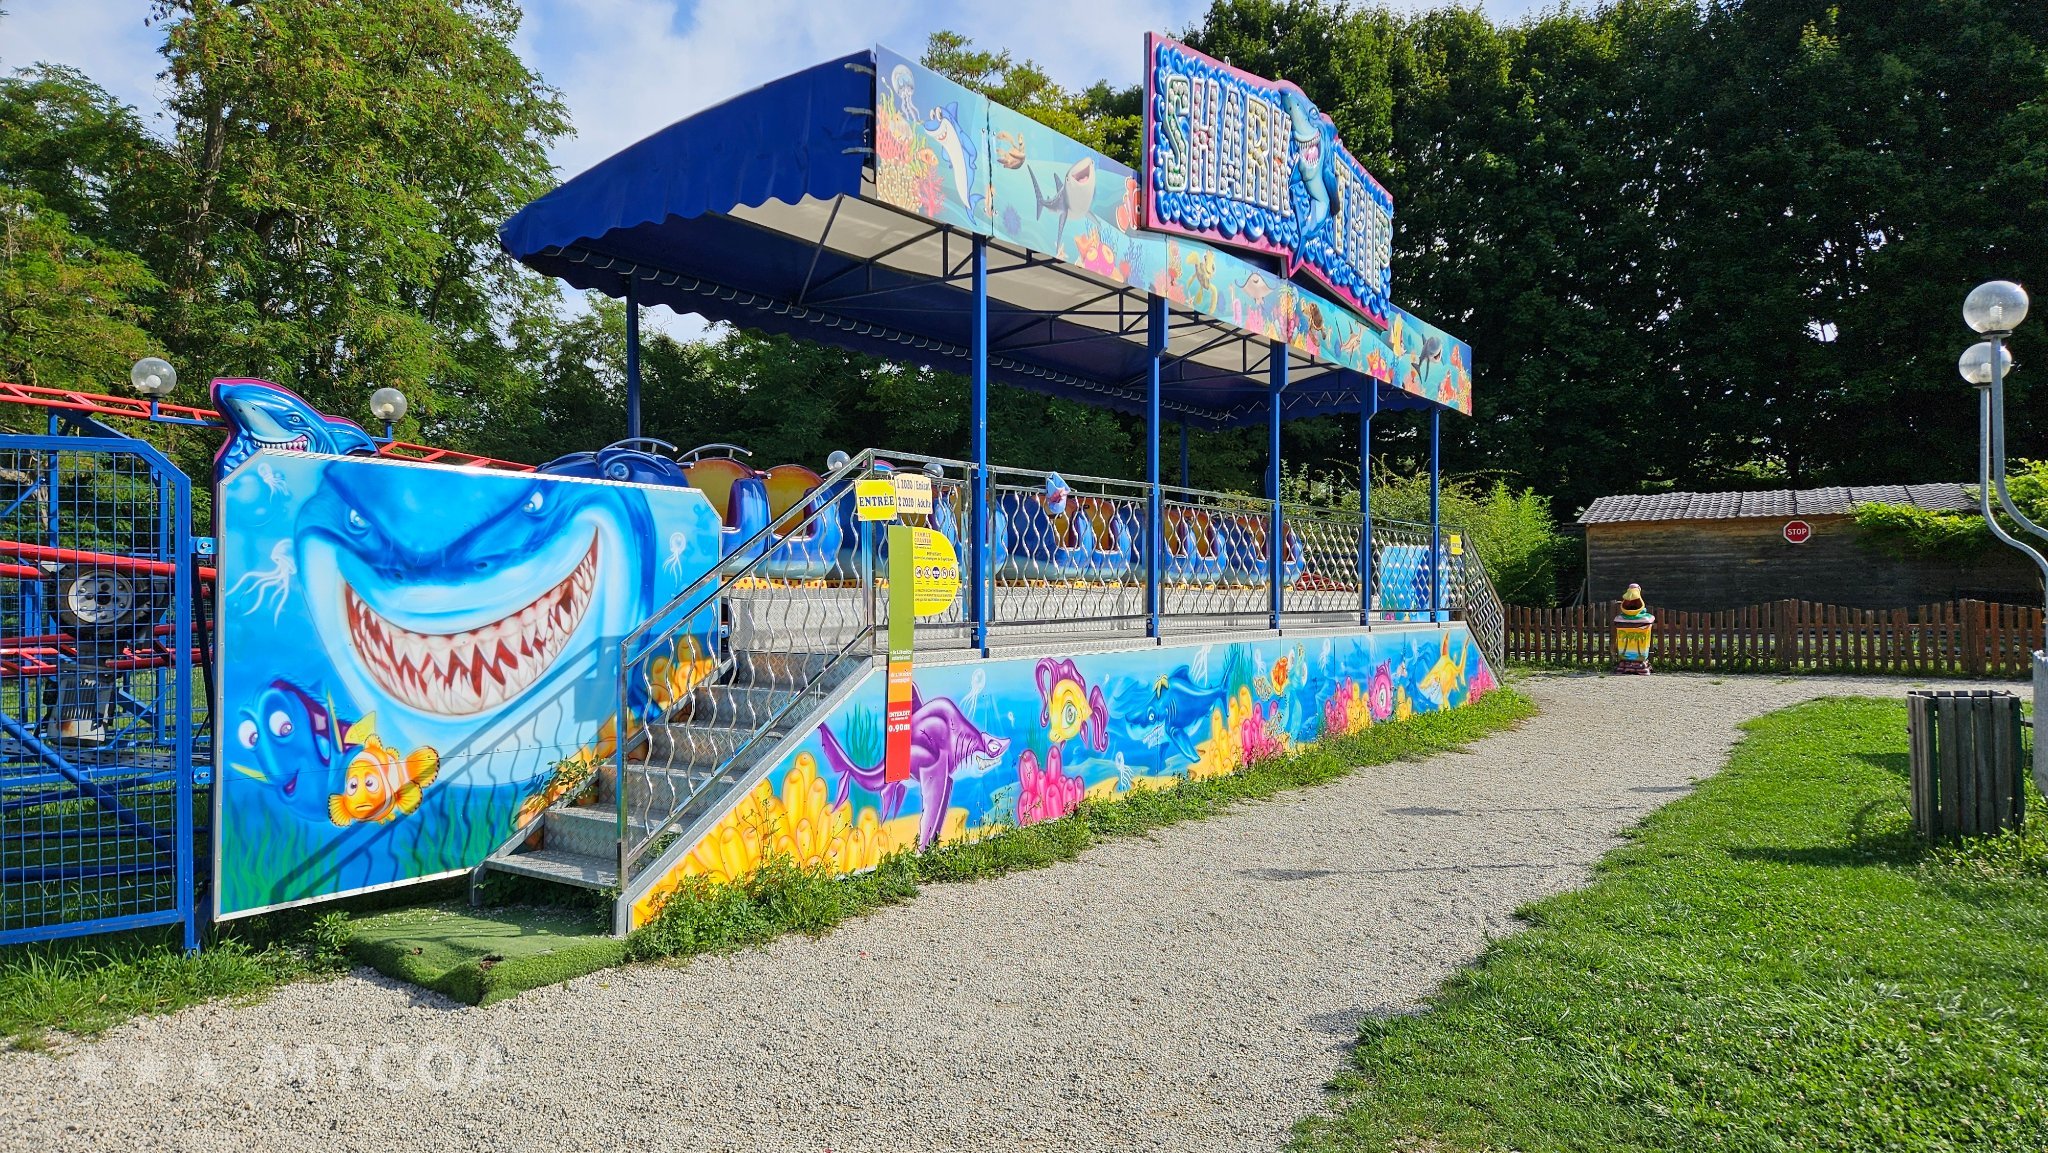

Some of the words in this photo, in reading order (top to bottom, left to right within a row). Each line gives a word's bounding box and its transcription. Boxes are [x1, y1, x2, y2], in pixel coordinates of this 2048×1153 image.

[1163, 74, 1291, 218] SHARK
[1333, 152, 1391, 294] TRIP
[859, 493, 894, 506] ENTRÉE
